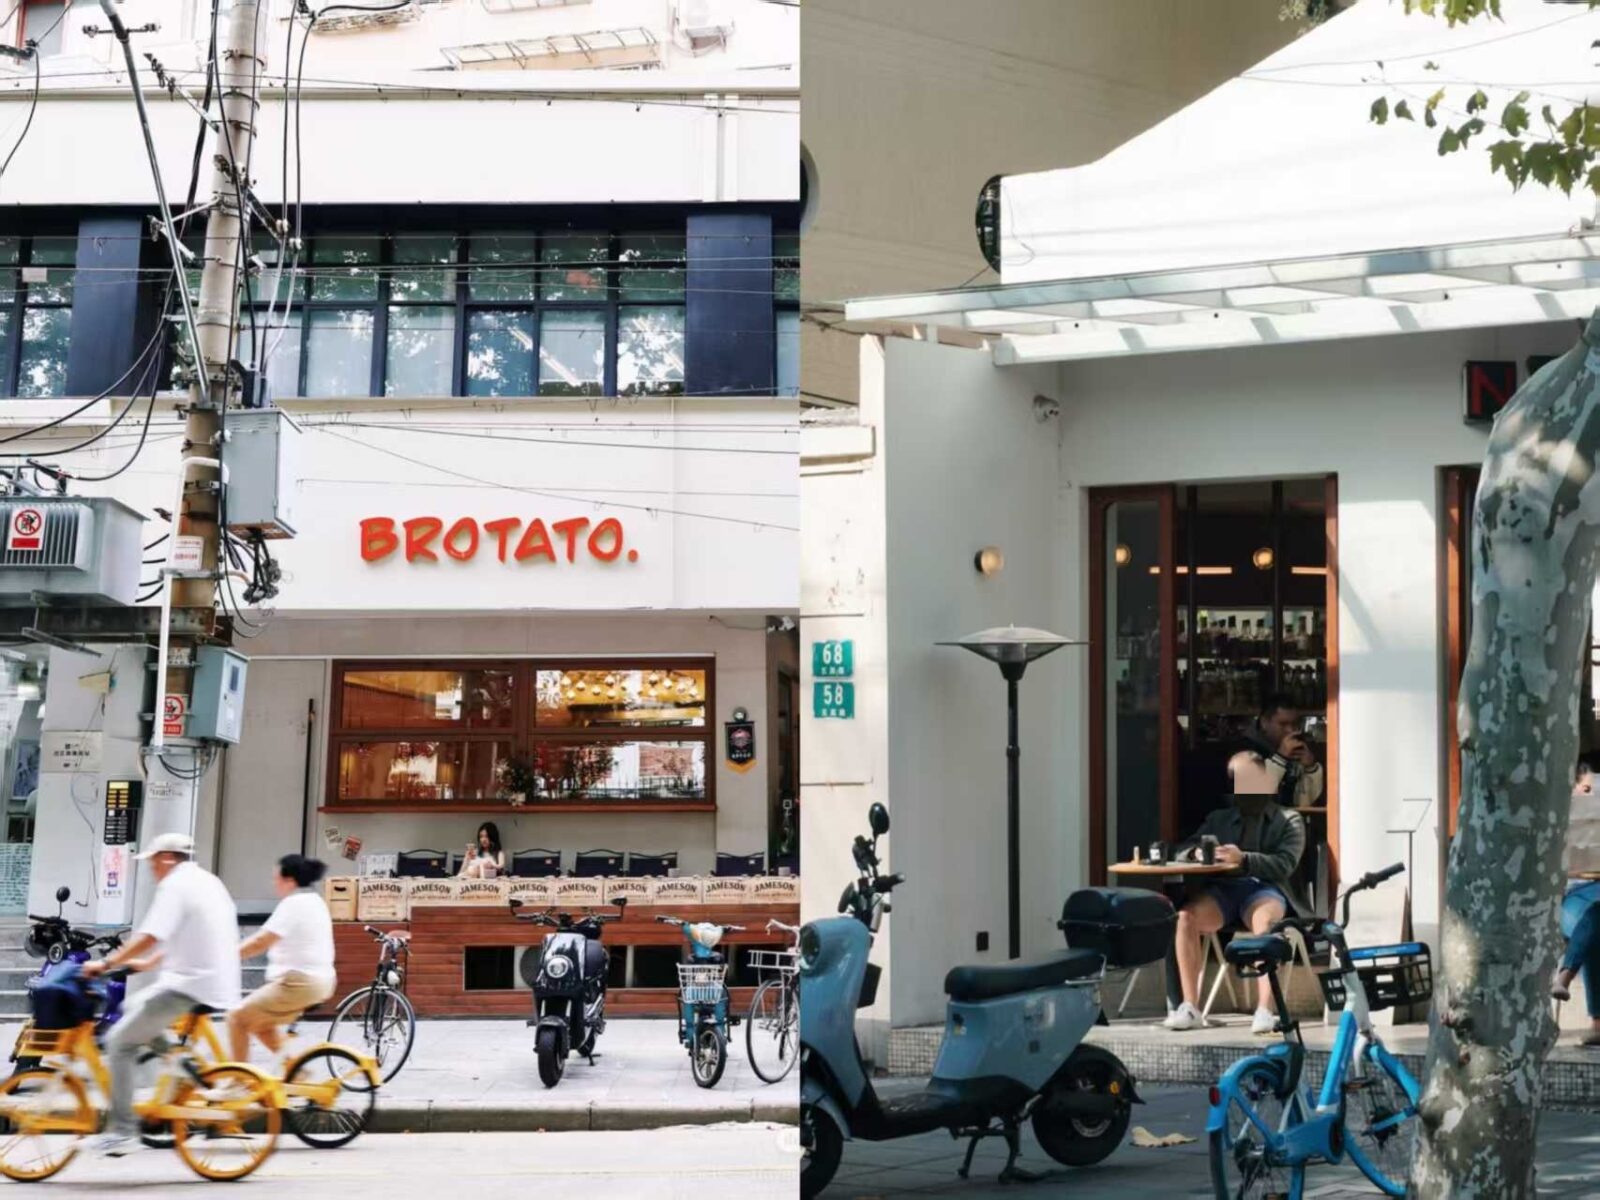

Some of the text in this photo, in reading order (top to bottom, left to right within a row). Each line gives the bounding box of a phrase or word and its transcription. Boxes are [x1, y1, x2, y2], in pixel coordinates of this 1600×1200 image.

[359, 516, 639, 563] BROTATO.
[822, 643, 843, 664] 68
[823, 684, 844, 705] 58
[361, 883, 402, 894] JAMESON
[411, 883, 451, 894] JAMESON
[460, 884, 500, 894] JAMESON
[508, 883, 548, 894] JAMESON
[557, 883, 597, 894] JAMESON
[608, 883, 647, 893] JAMESON
[656, 883, 697, 894] JAMESON
[706, 881, 746, 893] JAMESON
[754, 881, 795, 892] JAMESON
